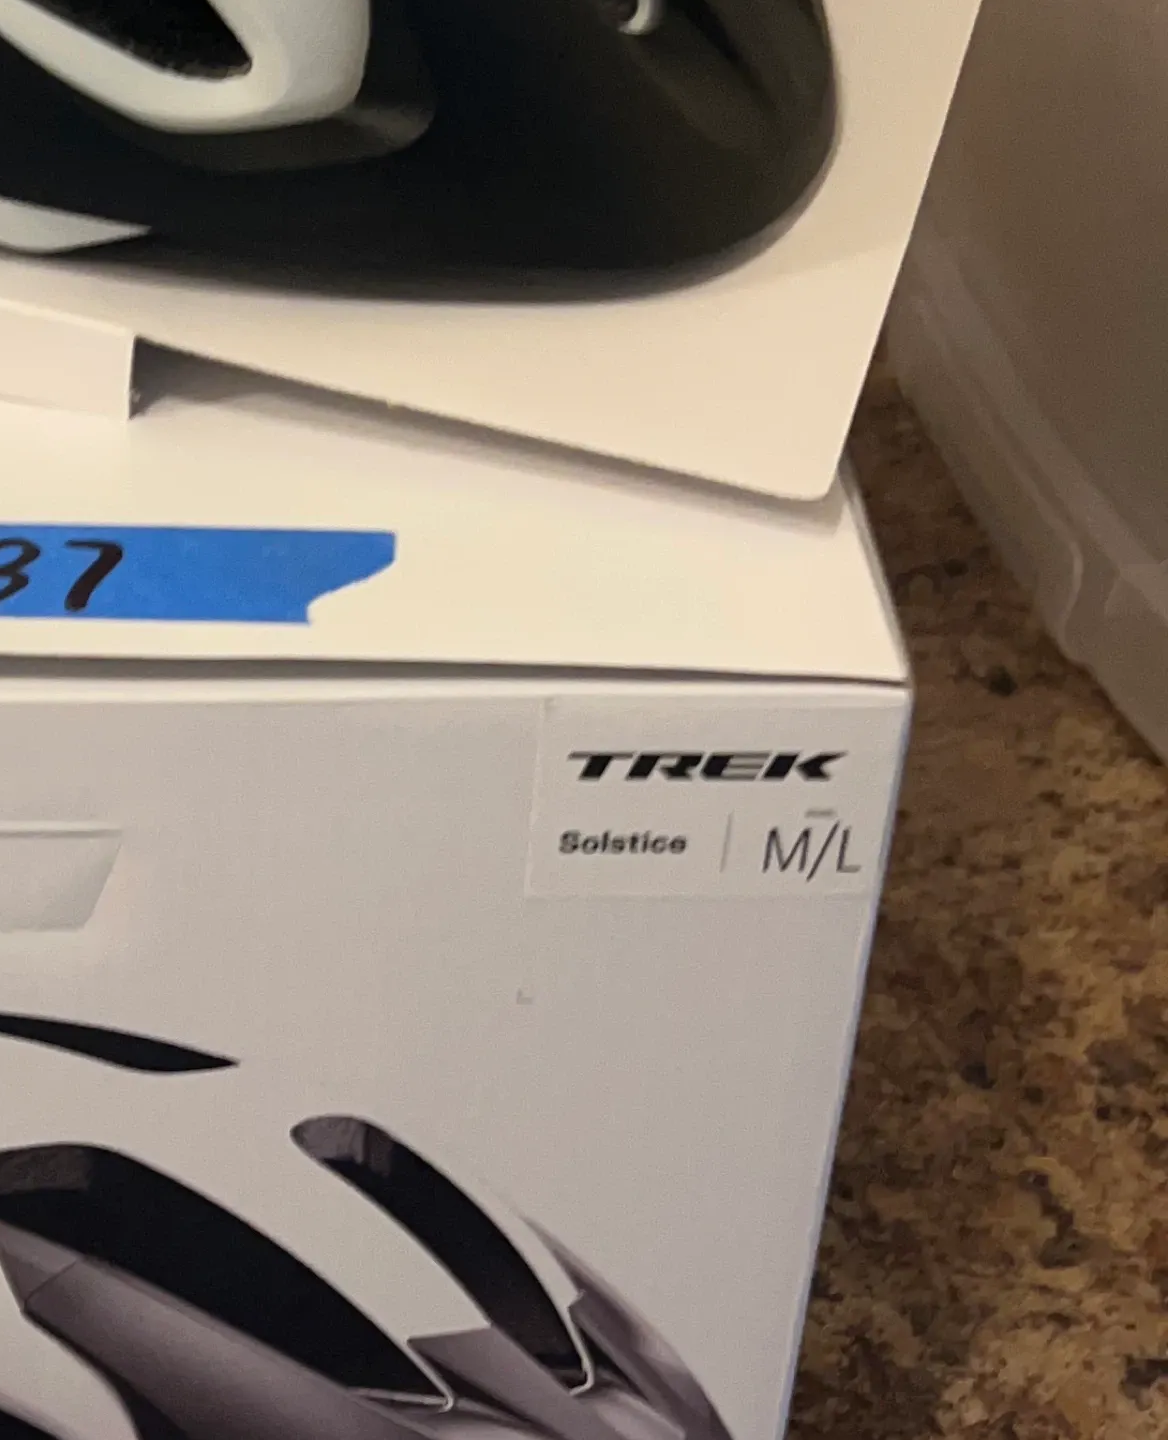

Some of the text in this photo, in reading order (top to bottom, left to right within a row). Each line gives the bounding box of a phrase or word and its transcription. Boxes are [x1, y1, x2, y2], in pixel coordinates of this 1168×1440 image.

[567, 750, 848, 781] TREK
[558, 820, 862, 882] Solstice M/L
